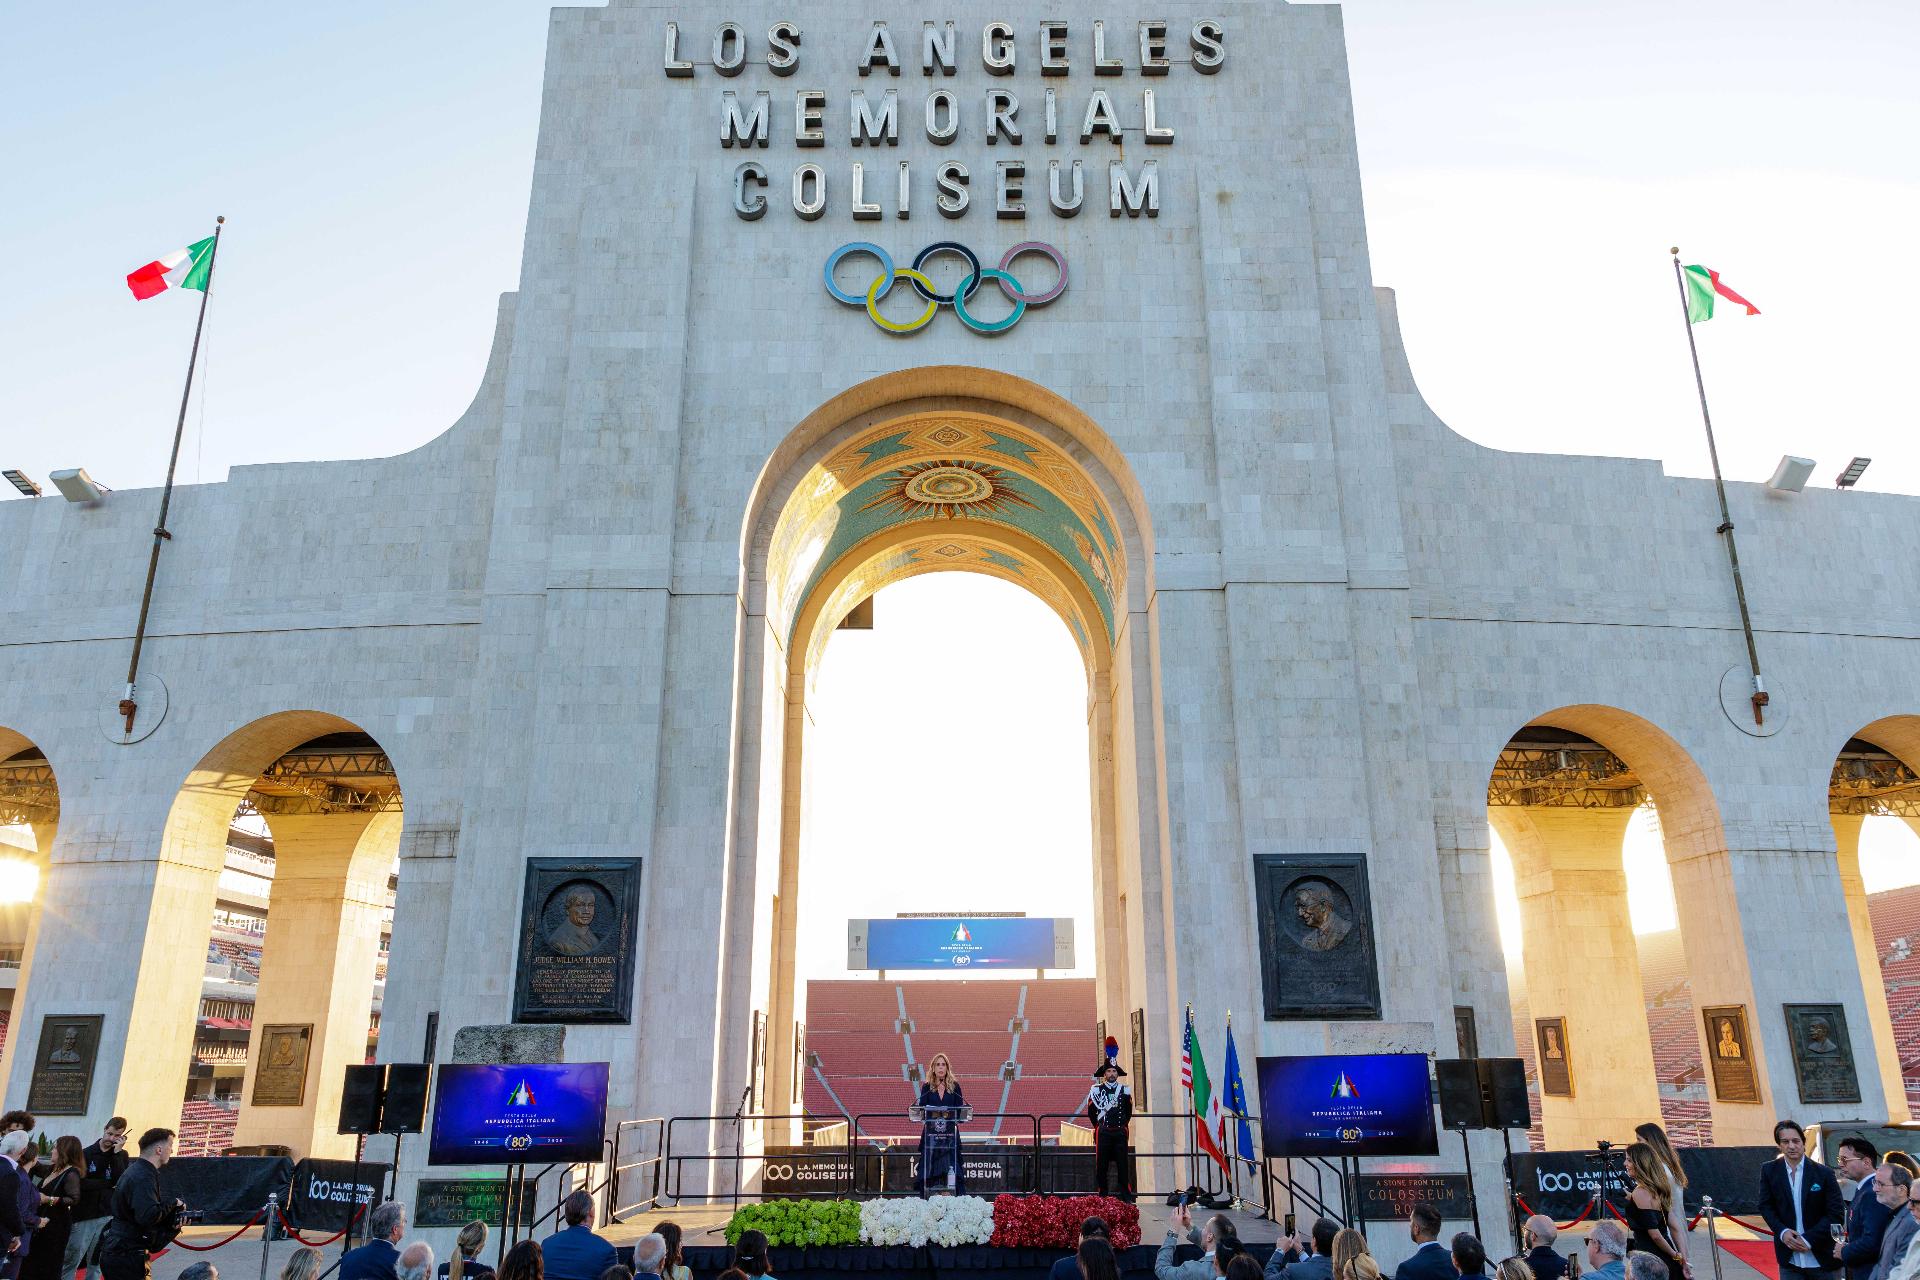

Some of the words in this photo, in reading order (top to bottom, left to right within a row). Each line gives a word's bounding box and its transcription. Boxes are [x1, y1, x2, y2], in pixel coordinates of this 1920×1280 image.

[664, 20, 800, 77] LOS
[857, 19, 1225, 76] ANGELES
[720, 88, 1174, 148] MEMORIAL
[733, 160, 1159, 221] COLISEUM
[533, 956, 554, 964] JUDGE
[556, 956, 584, 964] WILLIAM
[593, 956, 616, 964] BOWEN
[796, 1171, 854, 1180] COLISEUM
[963, 1169, 1002, 1179] ISEUM
[1368, 1188, 1454, 1201] COLOSSEUM
[447, 1209, 501, 1221] GREECE
